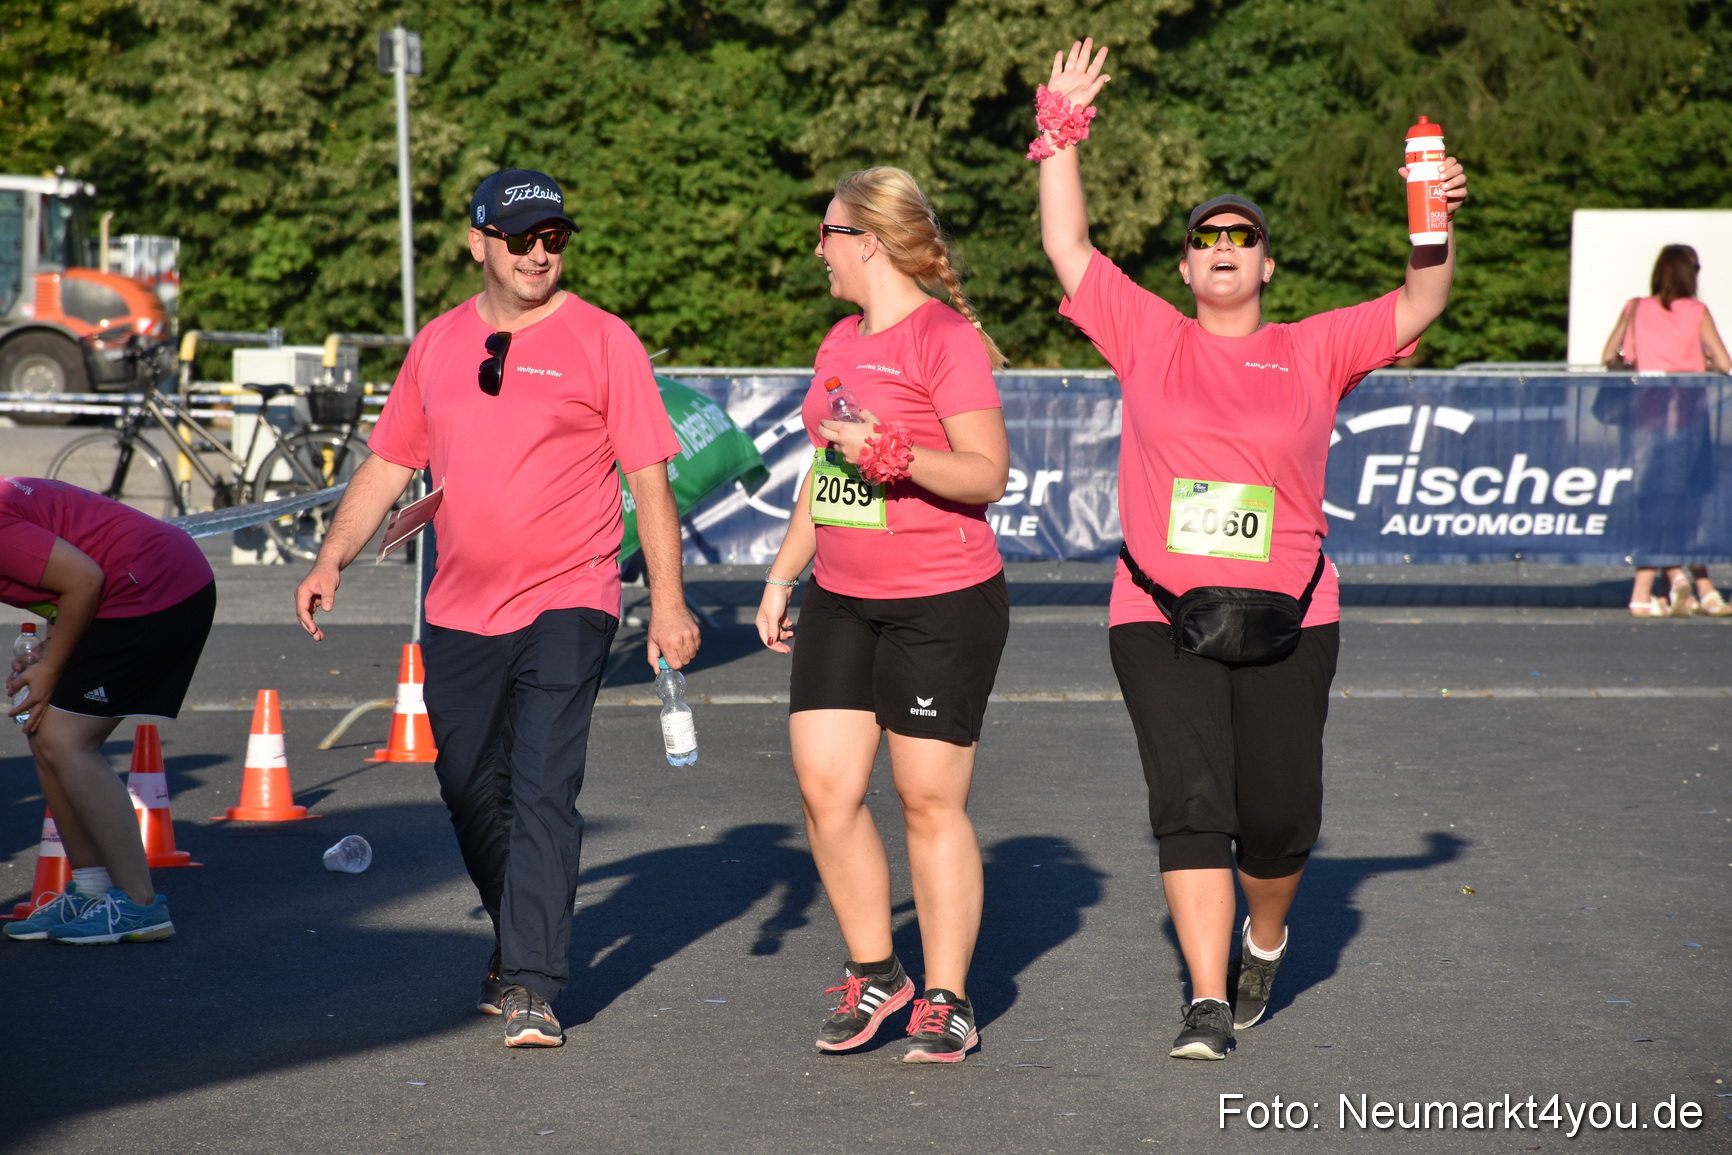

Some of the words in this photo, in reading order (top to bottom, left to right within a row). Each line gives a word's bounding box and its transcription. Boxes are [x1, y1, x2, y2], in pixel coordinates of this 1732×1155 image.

[502, 183, 561, 206] Titleist
[517, 366, 545, 376] Wolfgang
[816, 475, 873, 507] 2059
[1357, 453, 1634, 506] Fischer
[1180, 506, 1259, 539] 2060
[1380, 513, 1608, 536] AUTOMOBILE
[83, 693, 109, 702] adidas
[910, 707, 937, 716] erima
